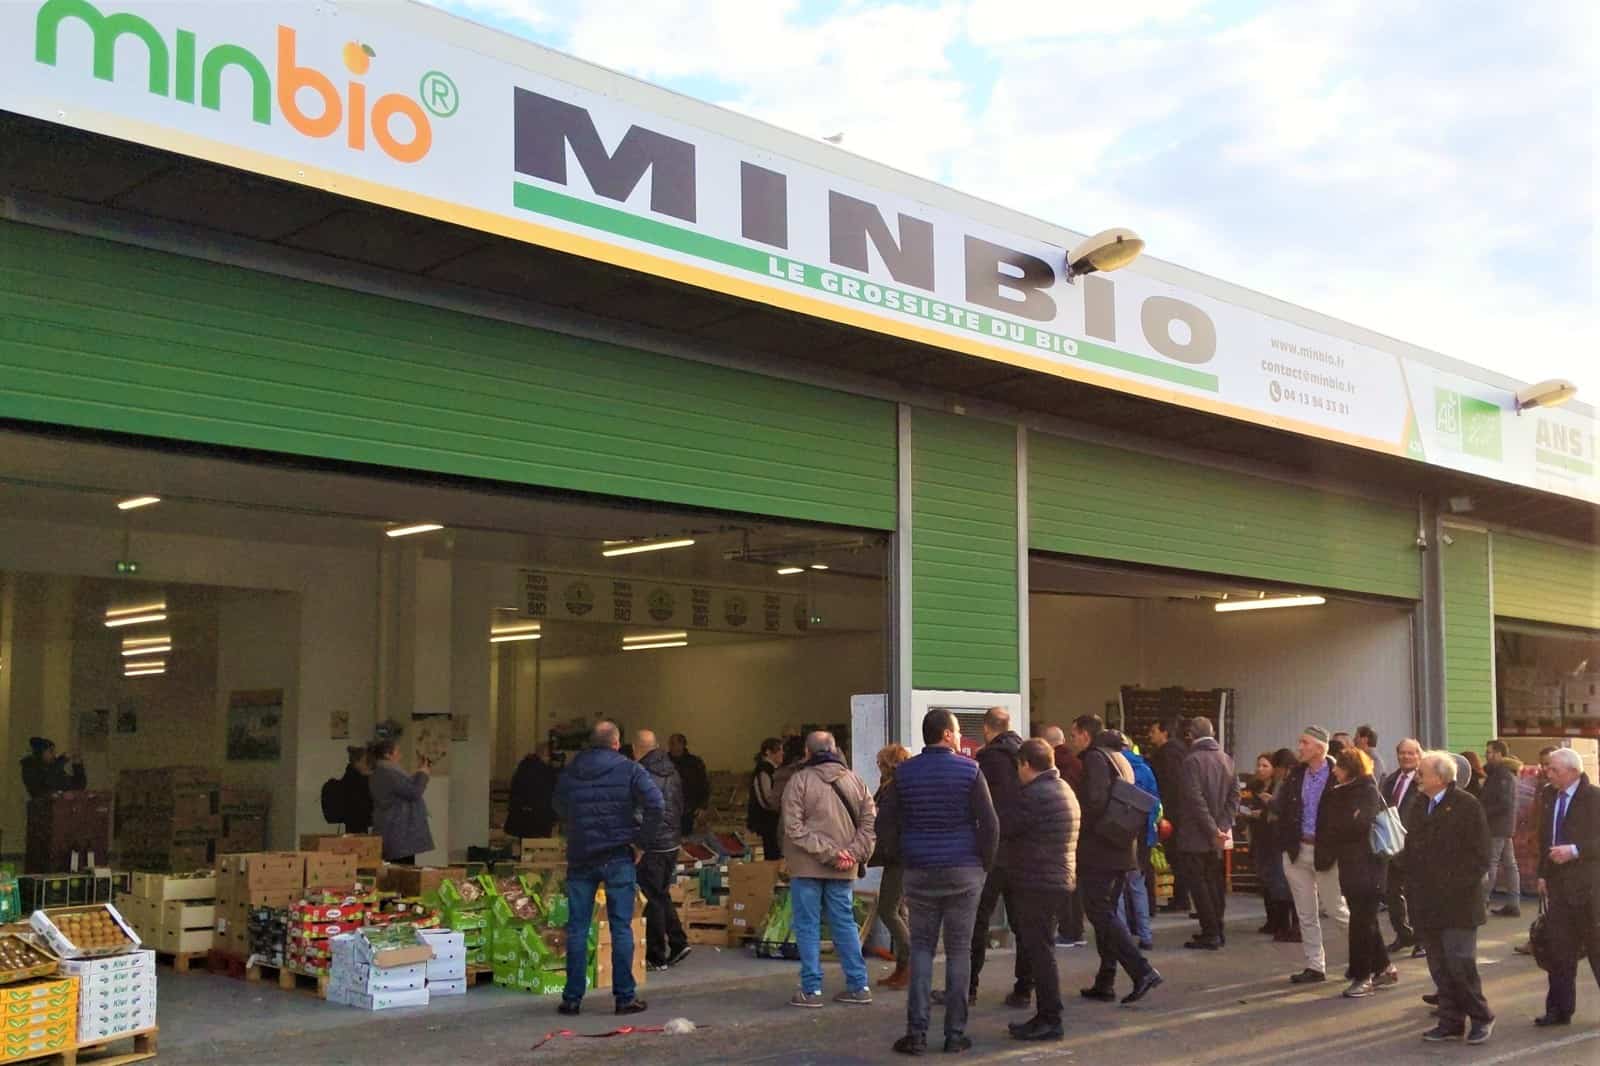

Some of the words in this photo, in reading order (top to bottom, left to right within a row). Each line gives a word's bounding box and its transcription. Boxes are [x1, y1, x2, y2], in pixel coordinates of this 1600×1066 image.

[514, 85, 1218, 366] MINBIO
[769, 256, 805, 287] LE
[821, 272, 980, 332] GROSSISTE
[991, 318, 1025, 345] DU
[1036, 334, 1079, 357] BIO
[1261, 359, 1355, 395] contact@minbio.fr
[1271, 337, 1345, 369] www.minbio.fr
